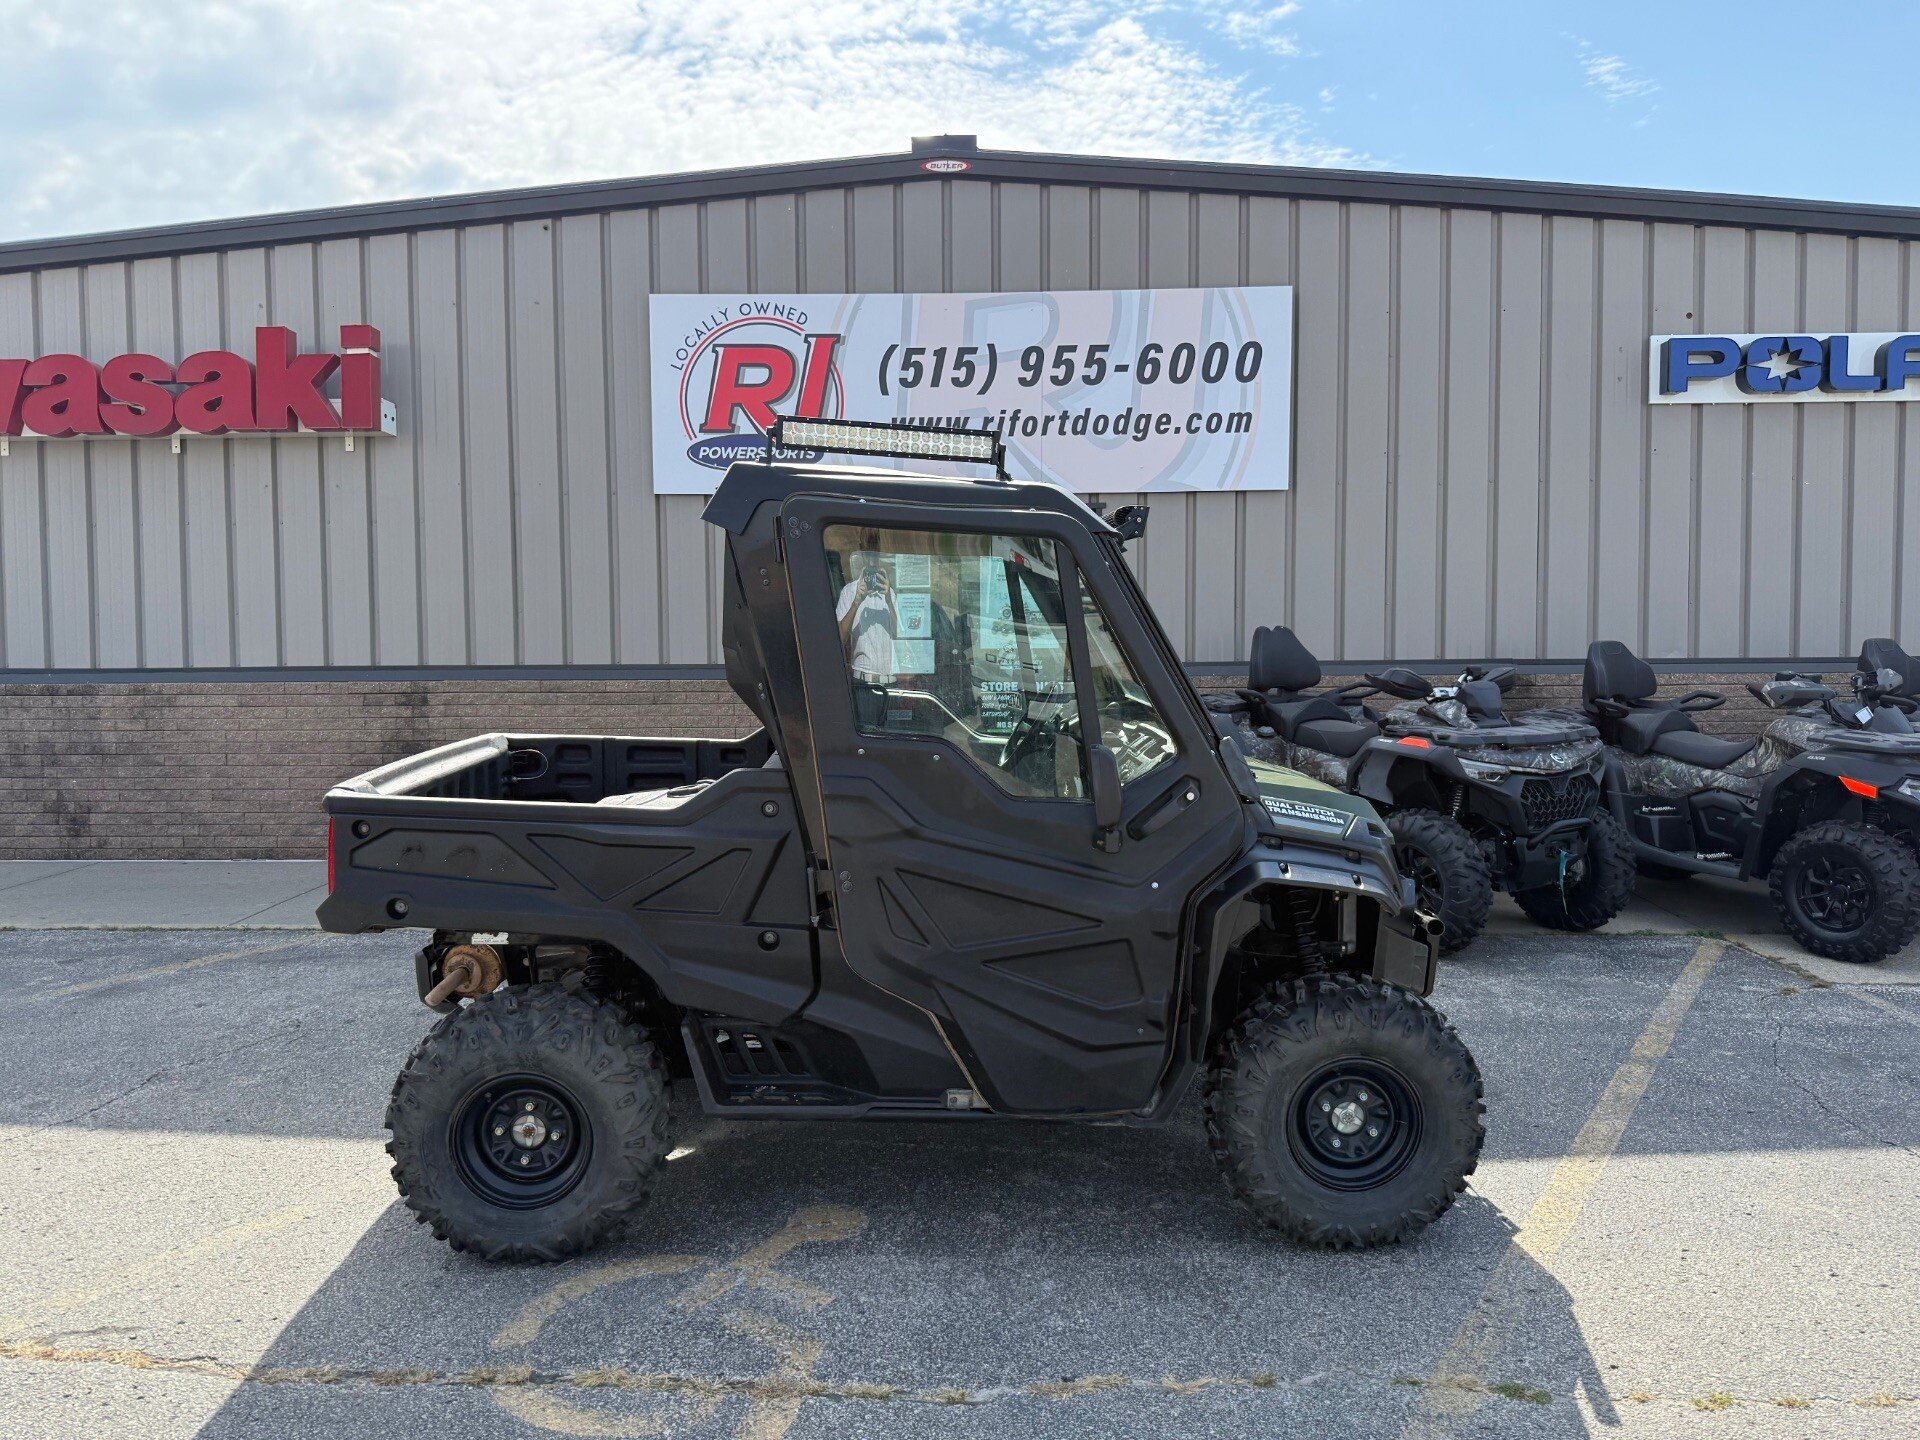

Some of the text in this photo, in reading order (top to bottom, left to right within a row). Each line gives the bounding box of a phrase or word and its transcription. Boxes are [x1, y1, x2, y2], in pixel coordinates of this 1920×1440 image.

[670, 301, 808, 371] LOCALLY OWNED
[699, 333, 844, 437] RI
[878, 340, 1263, 396] (515) 955-6000
[890, 406, 1253, 442] wrifortdodge.com
[980, 681, 1019, 692] STORE
[1264, 800, 1335, 817] DUAL CLUTCH
[1267, 806, 1345, 825] TRANSMISSION
